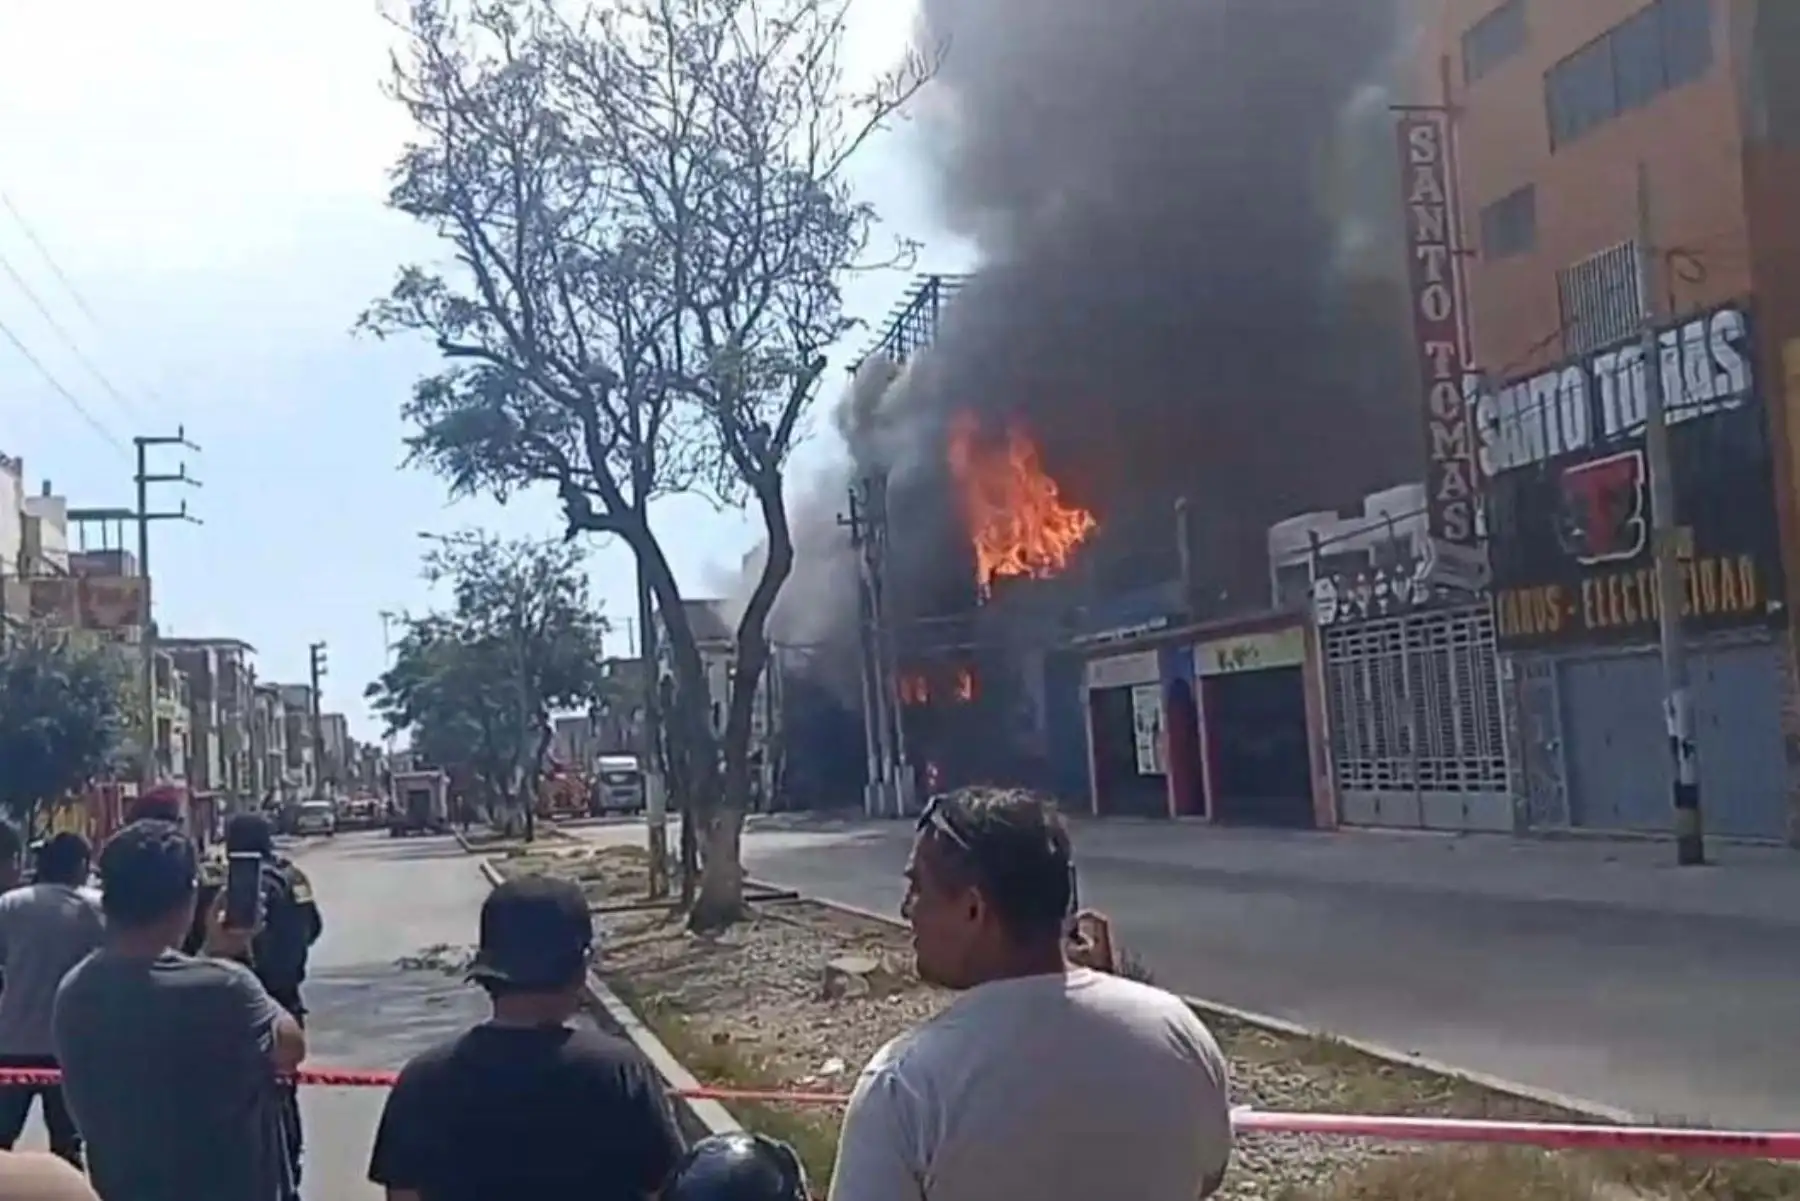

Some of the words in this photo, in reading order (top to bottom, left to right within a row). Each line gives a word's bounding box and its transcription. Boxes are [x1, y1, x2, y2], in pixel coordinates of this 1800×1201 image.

[1408, 125, 1452, 321] SANTO
[1425, 340, 1472, 540] TOMAS
[1475, 366, 1590, 477] SANTO
